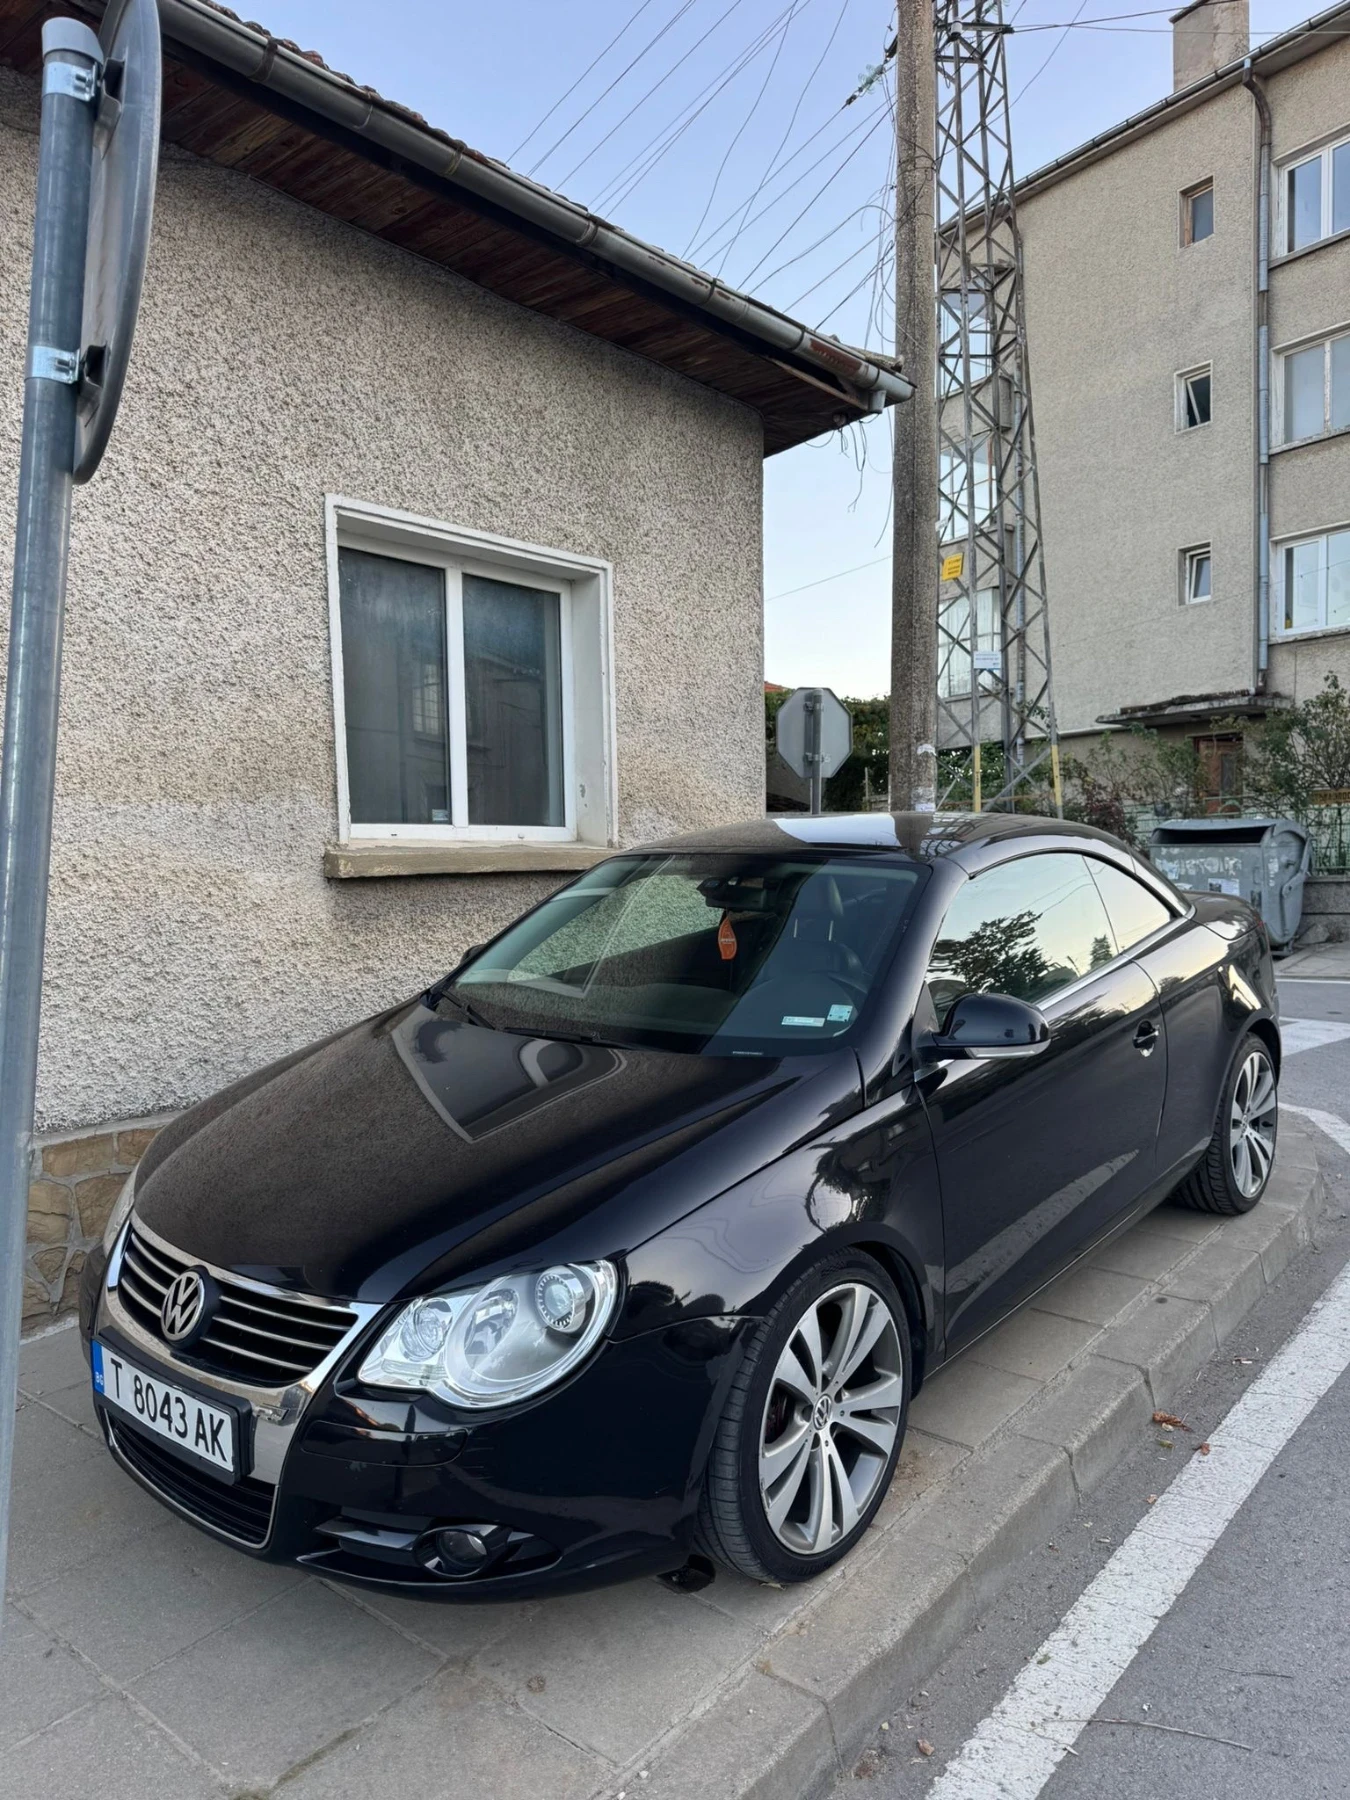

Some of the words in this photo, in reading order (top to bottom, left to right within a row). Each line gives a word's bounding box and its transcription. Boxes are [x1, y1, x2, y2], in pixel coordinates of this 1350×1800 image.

[162, 1271, 203, 1341] VW
[110, 1357, 122, 1399] T
[133, 1374, 188, 1439] 8043
[195, 1408, 228, 1462] AK
